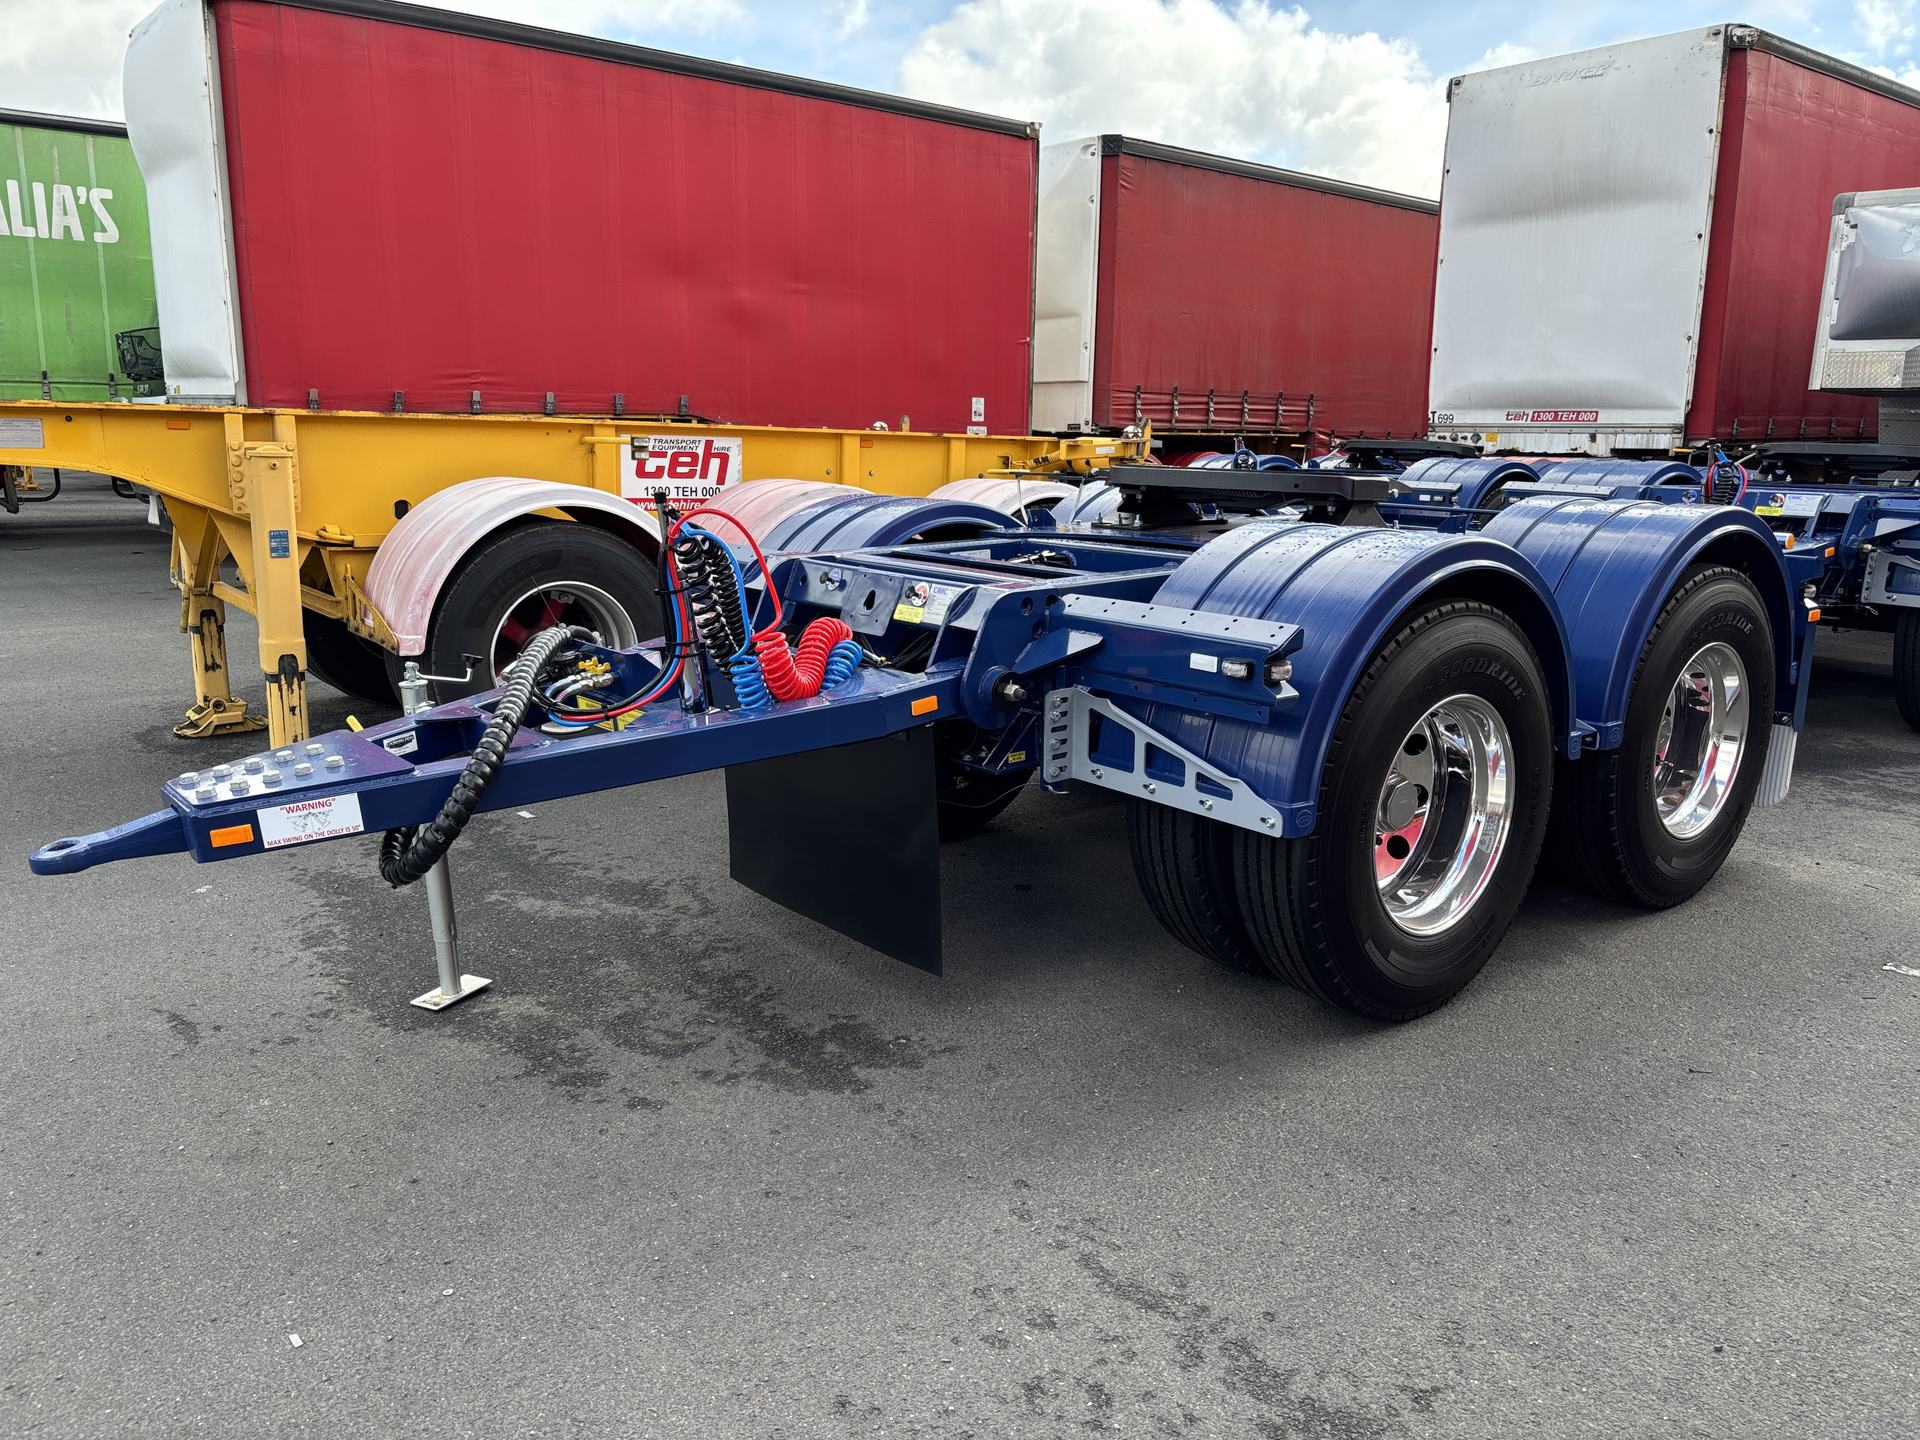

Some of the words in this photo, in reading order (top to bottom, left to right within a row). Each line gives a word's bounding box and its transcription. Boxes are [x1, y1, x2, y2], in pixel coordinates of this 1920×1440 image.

[1438, 413, 1454, 424] 699
[1505, 411, 1530, 422] teh
[1533, 412, 1554, 421] 1300
[1557, 412, 1577, 421] TEH
[1578, 412, 1596, 421] 000
[653, 438, 702, 446] TRANSPORT
[651, 444, 700, 452] EQUIPMENT
[635, 439, 730, 486] teh
[674, 486, 698, 497] TEH
[701, 486, 721, 497] 000
[267, 838, 282, 847] MAX
[282, 835, 303, 844] SWING
[304, 833, 314, 841] ON
[327, 828, 344, 836] DOLLY
